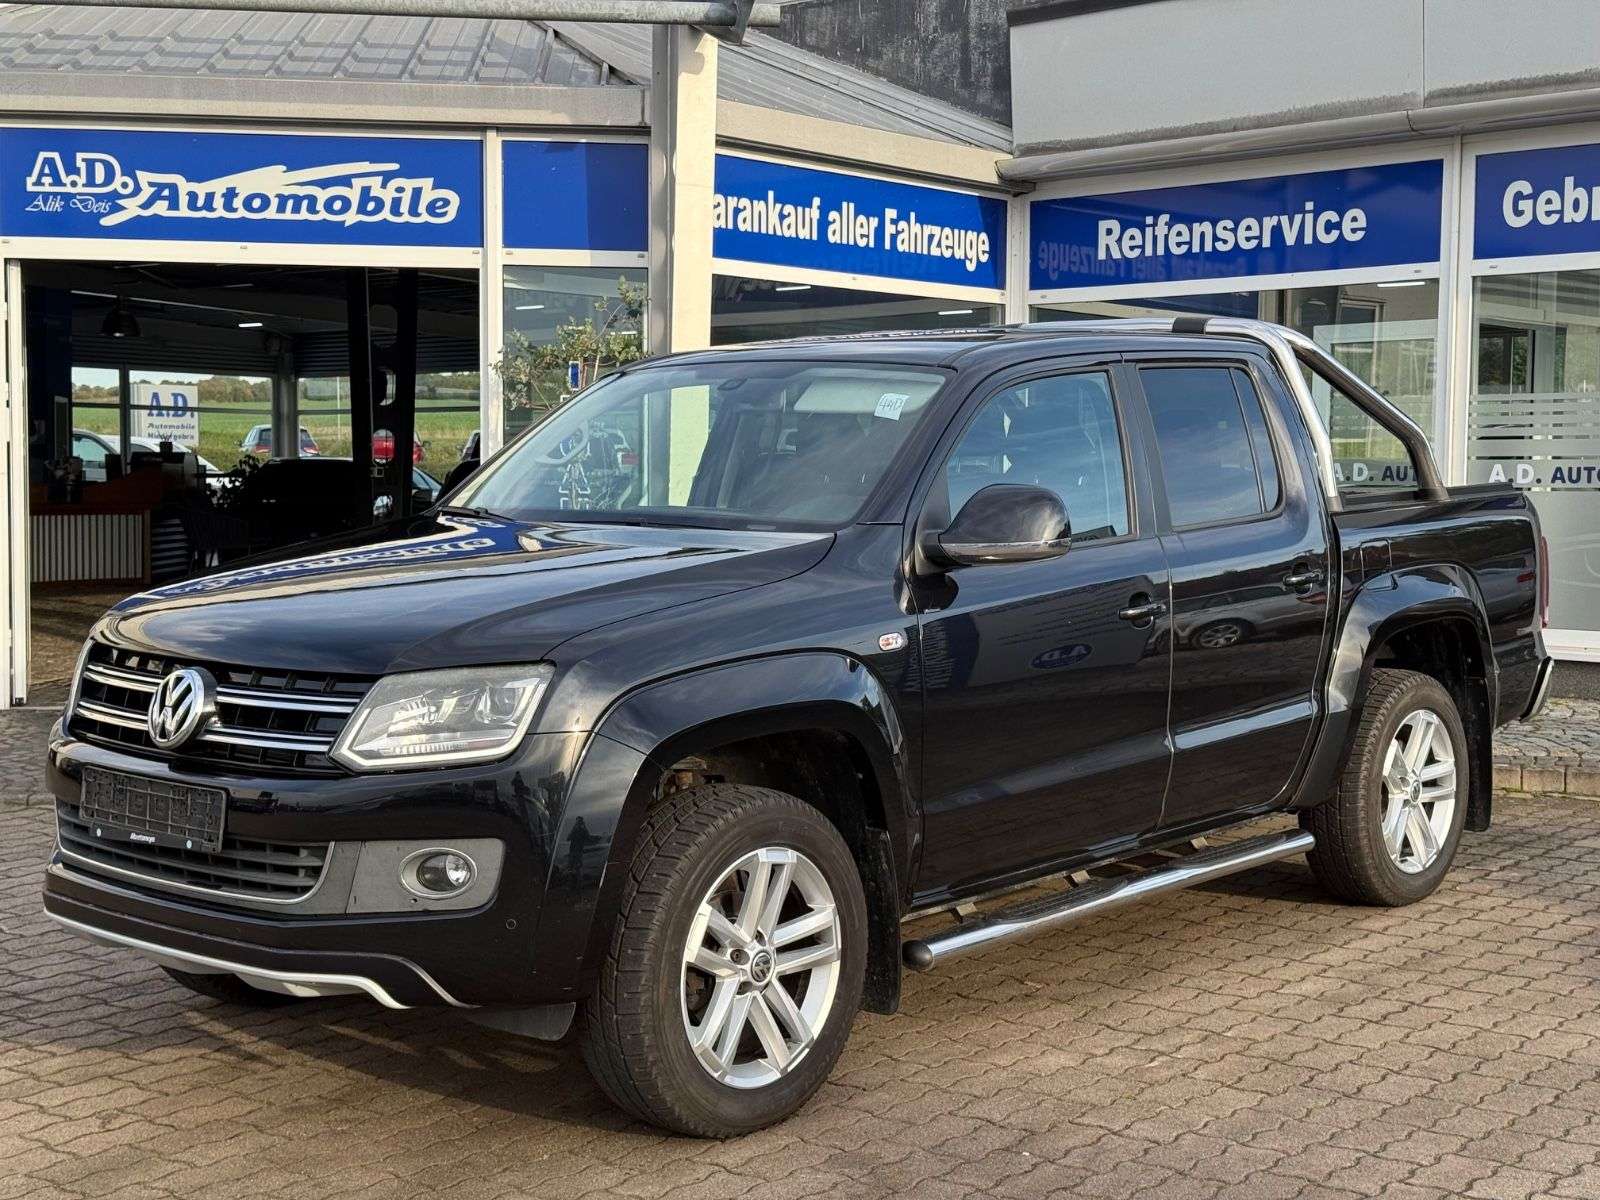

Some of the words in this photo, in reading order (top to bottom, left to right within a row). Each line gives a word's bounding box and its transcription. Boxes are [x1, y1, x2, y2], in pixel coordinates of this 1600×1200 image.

[28, 153, 133, 193] A.D.
[137, 177, 457, 223] Automobile
[827, 201, 878, 248] aller
[884, 207, 990, 272] Fahrzeuge
[1097, 201, 1367, 261] Reifenservice
[1488, 463, 1542, 484] A.D.
[1551, 466, 1600, 484] AUT
